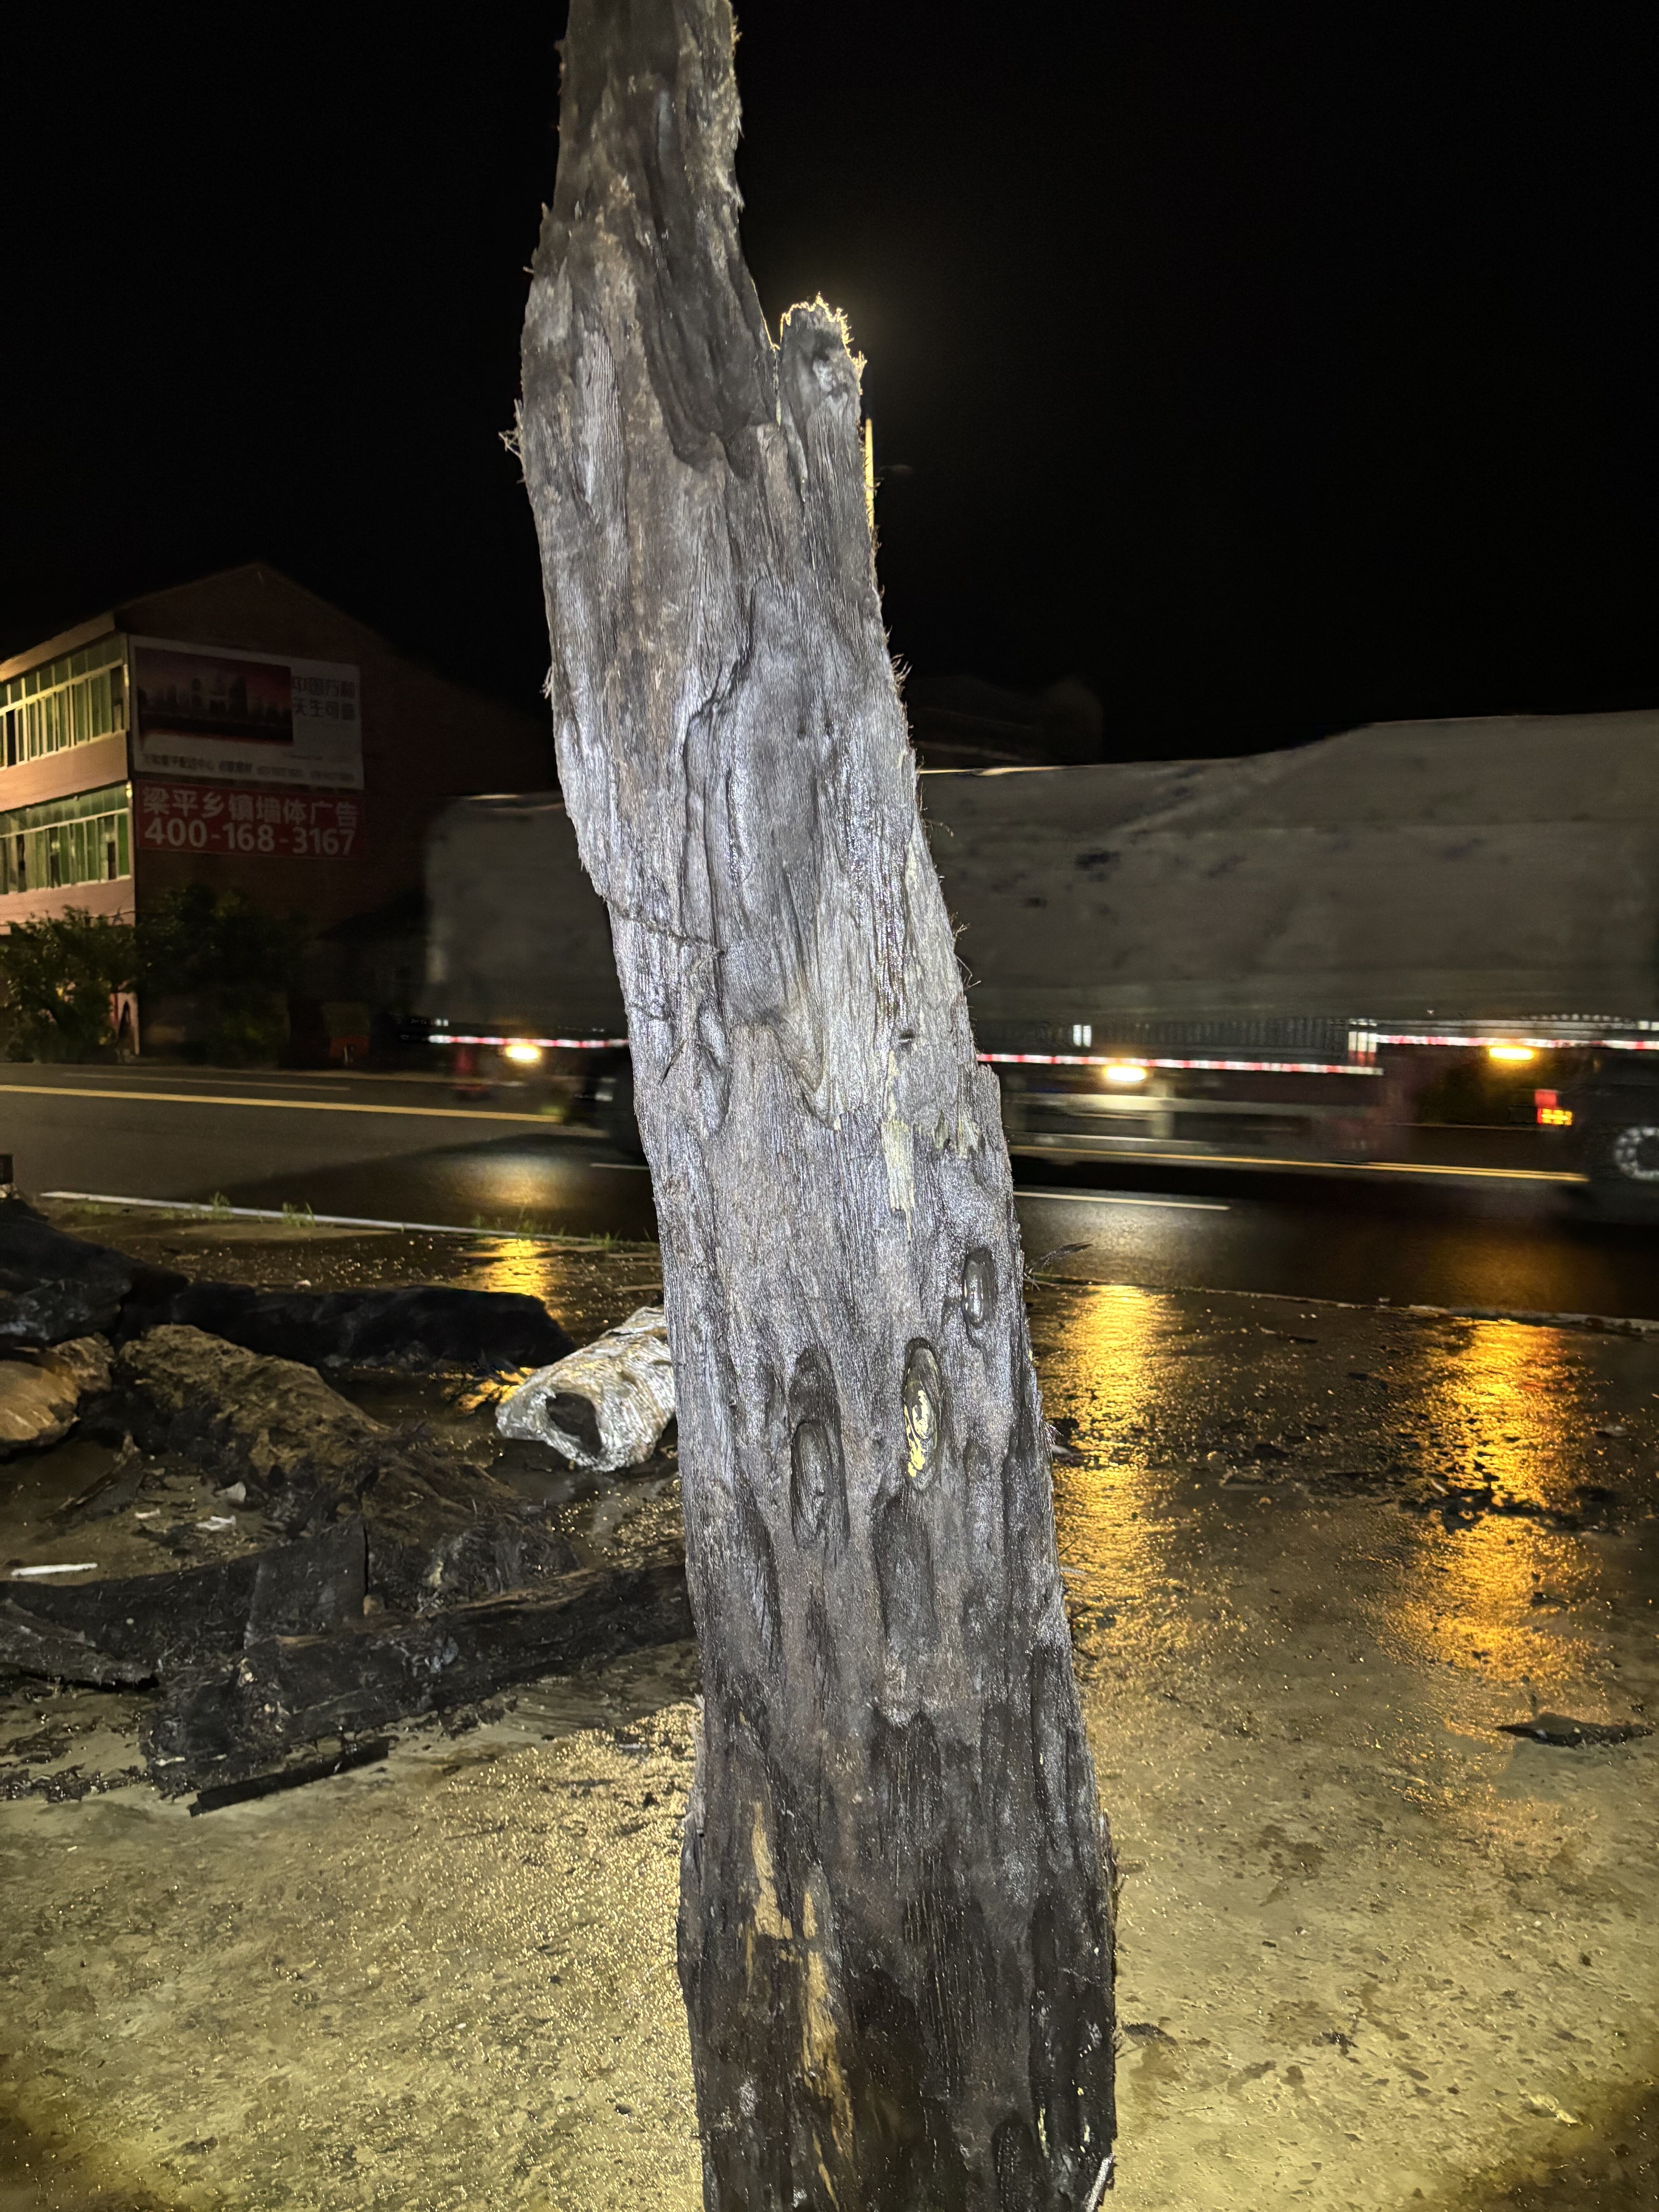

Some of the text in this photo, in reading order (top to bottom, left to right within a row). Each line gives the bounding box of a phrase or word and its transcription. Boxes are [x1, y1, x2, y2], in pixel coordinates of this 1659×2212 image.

[142, 787, 358, 830] 梁平乡镇墙体广告
[144, 817, 355, 855] 400-168-3167
